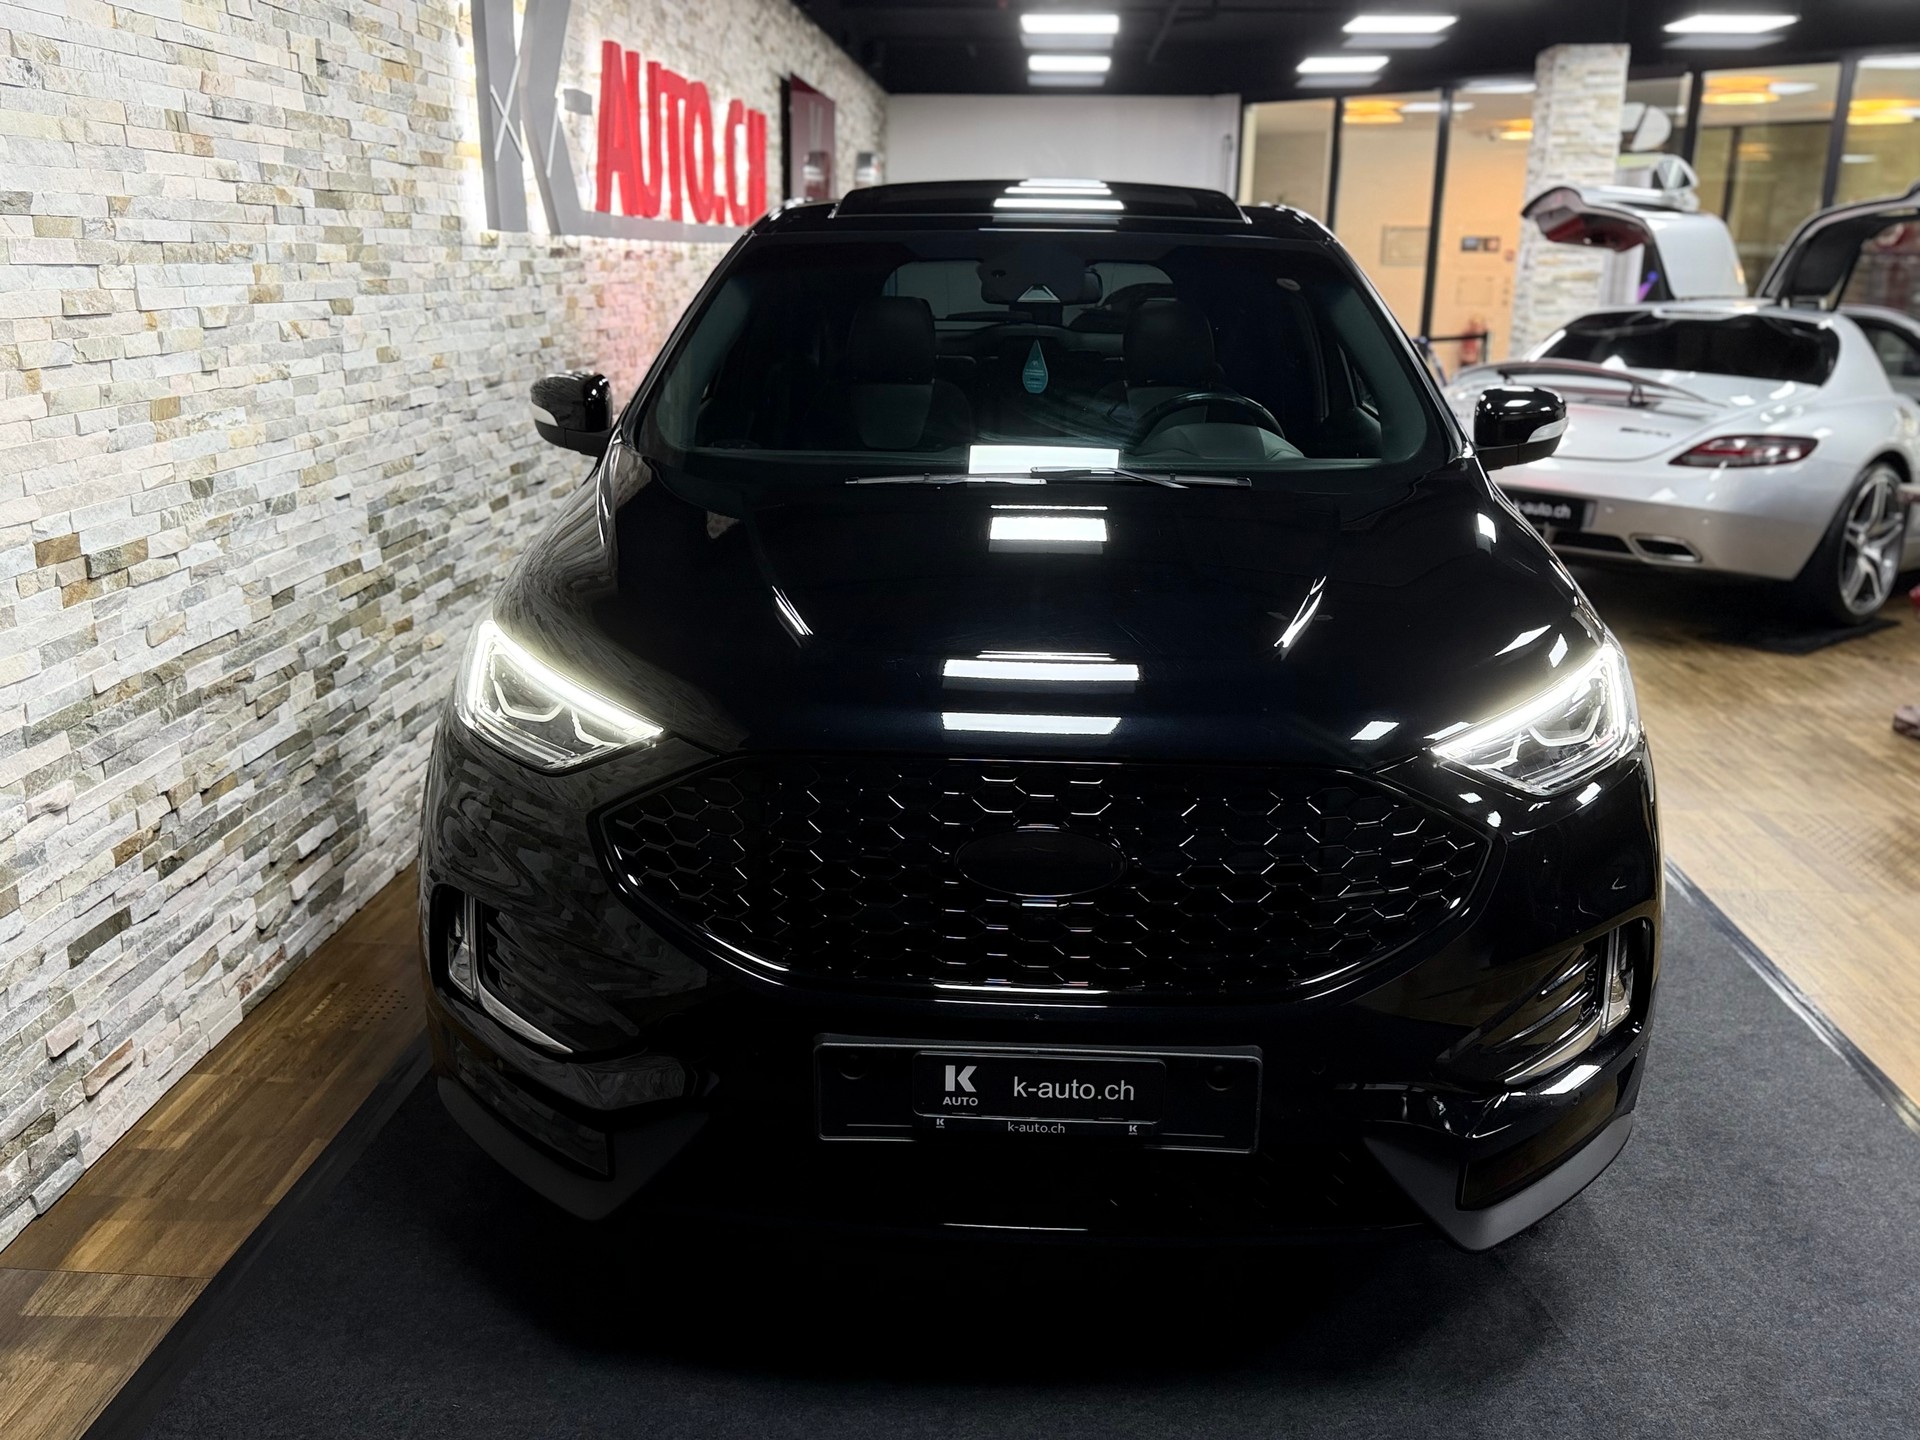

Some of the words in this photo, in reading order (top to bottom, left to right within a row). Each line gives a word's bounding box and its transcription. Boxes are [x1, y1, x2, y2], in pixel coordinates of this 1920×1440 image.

[945, 1064, 978, 1092] K
[1013, 1076, 1135, 1101] k-auto.ch
[942, 1096, 979, 1106] AUTO
[1007, 1121, 1066, 1134] k-auto.ch
